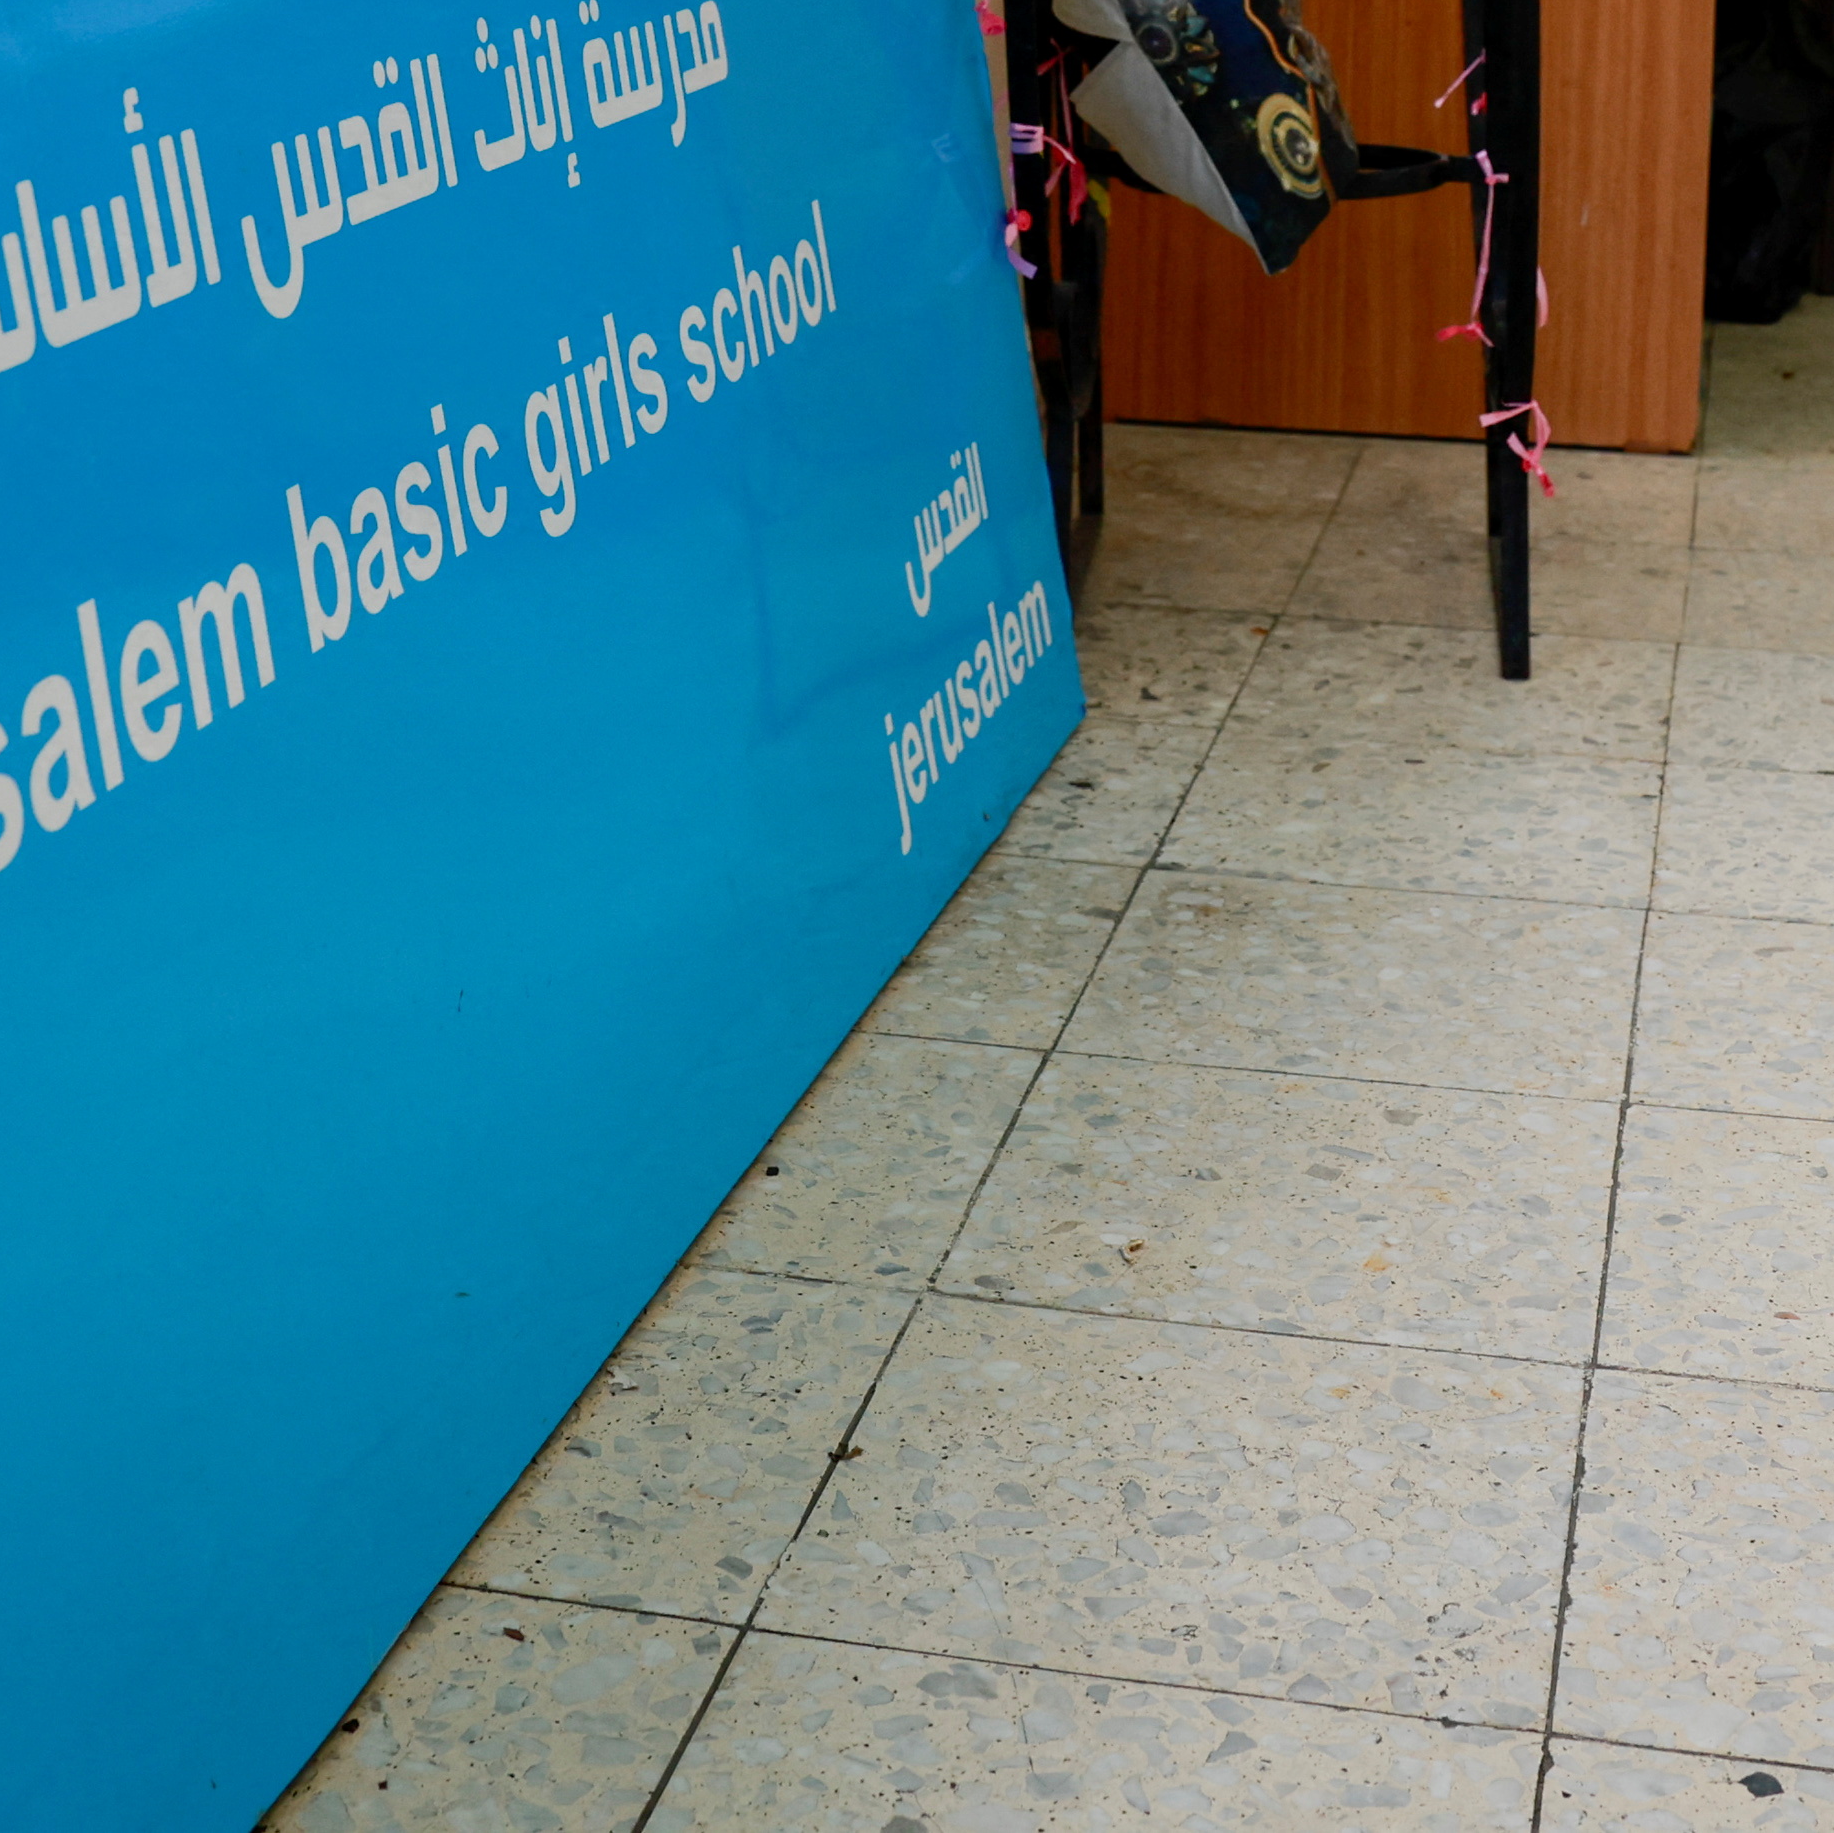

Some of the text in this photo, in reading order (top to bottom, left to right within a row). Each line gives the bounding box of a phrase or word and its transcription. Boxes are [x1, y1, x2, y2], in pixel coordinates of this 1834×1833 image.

[240, 52, 459, 320] القدس
[473, 15, 582, 188] إناث
[286, 403, 509, 653] basic
[523, 312, 670, 539] girls
[678, 201, 838, 405] school
[904, 441, 989, 619] القدس
[884, 578, 1054, 856] jerusalem
